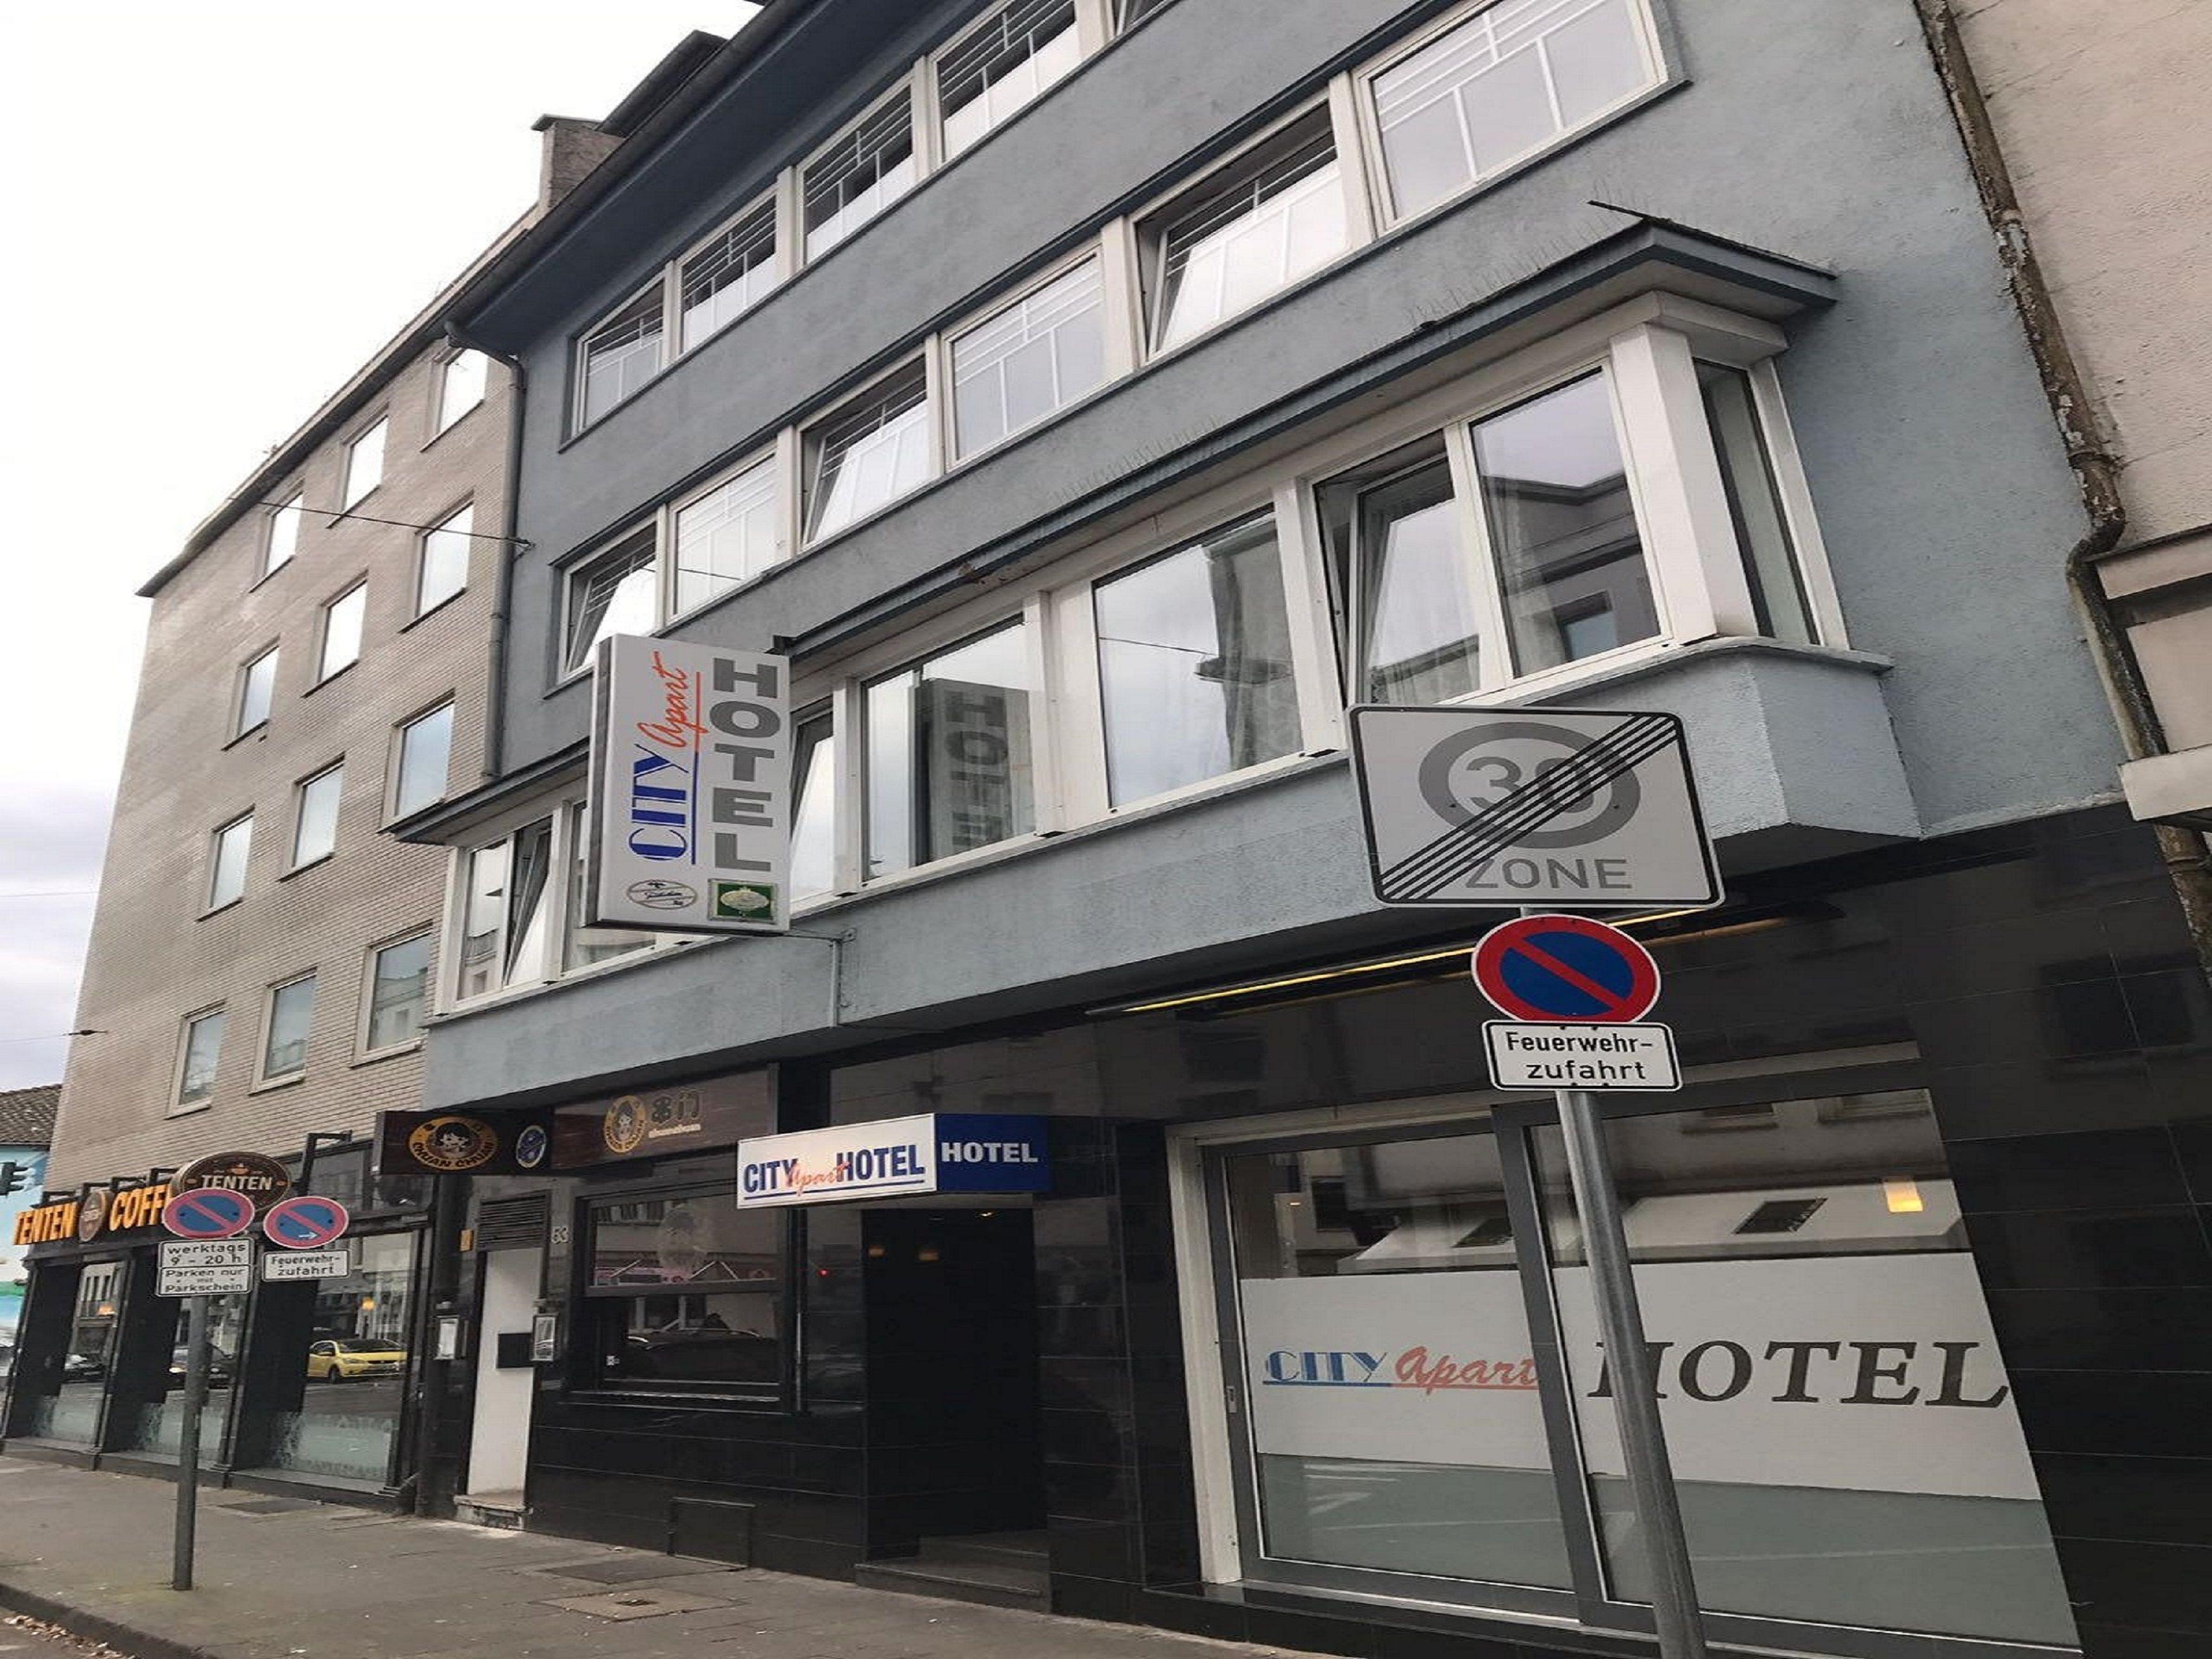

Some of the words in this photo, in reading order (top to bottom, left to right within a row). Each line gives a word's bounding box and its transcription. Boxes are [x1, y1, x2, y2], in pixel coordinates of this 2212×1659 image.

[709, 657, 781, 872] HOTEL
[1466, 756, 1595, 814] 30
[629, 743, 689, 861] CITY
[1466, 858, 1632, 890] ZONE
[1507, 1031, 1653, 1054] Feuerwehr-
[1527, 1060, 1646, 1080] zufahrt
[941, 1142, 1038, 1163] HOTEL
[743, 1158, 798, 1193] CITY
[836, 1145, 925, 1183] HOTEL
[202, 1174, 272, 1190] TENTEN
[15, 1201, 78, 1245] TENTEN
[109, 1184, 170, 1231] COFF
[167, 1244, 246, 1255] werktags
[171, 1256, 178, 1265] 9
[205, 1255, 224, 1265] 20
[232, 1254, 241, 1263] h
[272, 1255, 341, 1265] Feuerwehr-
[166, 1269, 215, 1278] Parken
[221, 1268, 244, 1277] nur
[277, 1264, 334, 1276] zufahrt
[165, 1284, 243, 1293] Parkschein
[1265, 1351, 1387, 1382] CITY
